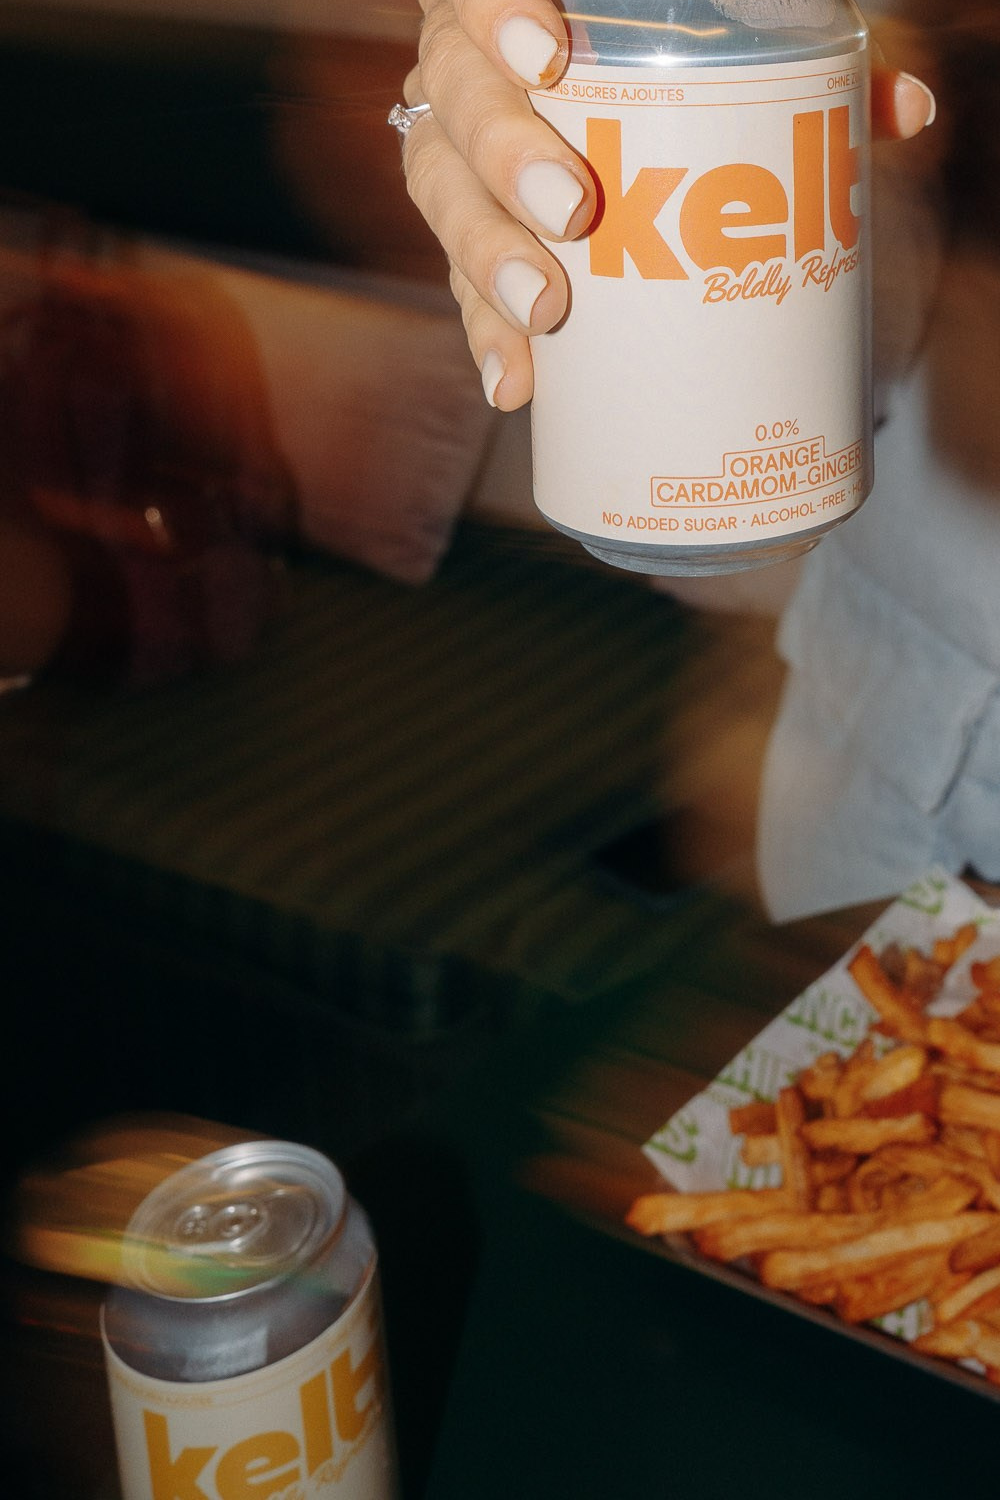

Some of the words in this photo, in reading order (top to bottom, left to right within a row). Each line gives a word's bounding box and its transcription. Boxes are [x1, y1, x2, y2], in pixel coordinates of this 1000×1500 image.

[571, 84, 617, 100] SUCRES
[620, 88, 685, 101] AJOUTES
[827, 74, 850, 90] OHNE
[586, 105, 861, 280] kelt
[702, 263, 792, 305] Boldly
[755, 419, 800, 442] 0.0%
[730, 442, 820, 477] ORANGE
[602, 511, 623, 527] NO
[627, 515, 679, 531] ADDED
[684, 516, 737, 531] SUGAR
[750, 490, 846, 527] ALCOHOL-FREE
[143, 1347, 384, 1500] kelt
